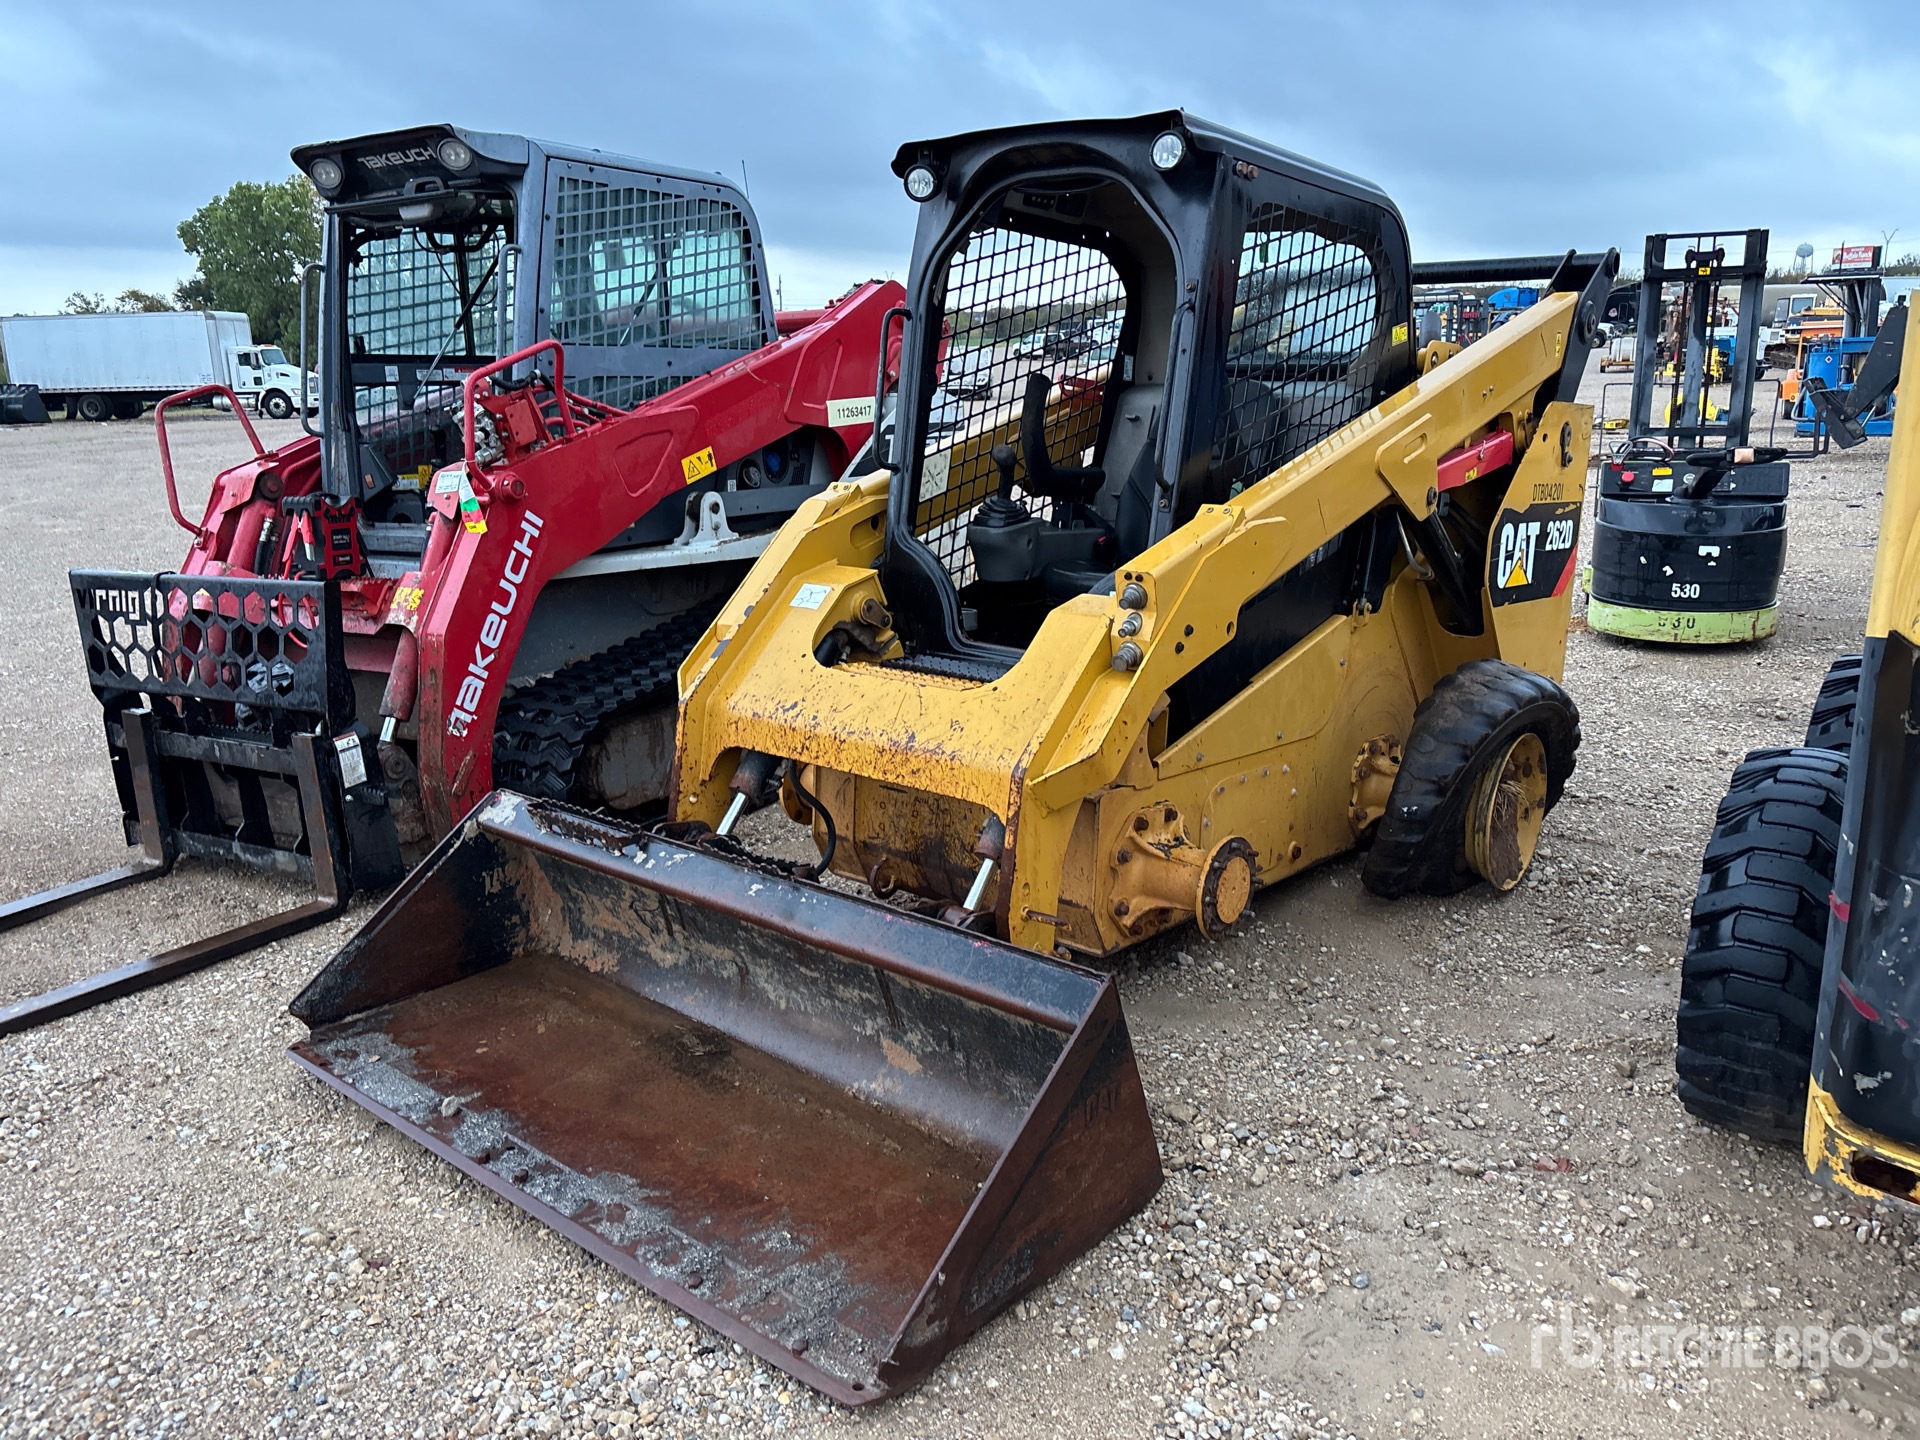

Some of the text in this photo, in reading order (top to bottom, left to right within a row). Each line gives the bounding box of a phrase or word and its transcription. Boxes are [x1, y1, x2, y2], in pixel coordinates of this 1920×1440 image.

[357, 146, 437, 169] TAKEUCH
[837, 406, 871, 419] 11263417
[1496, 519, 1574, 589] CAT 262D
[1671, 583, 1700, 598] 530
